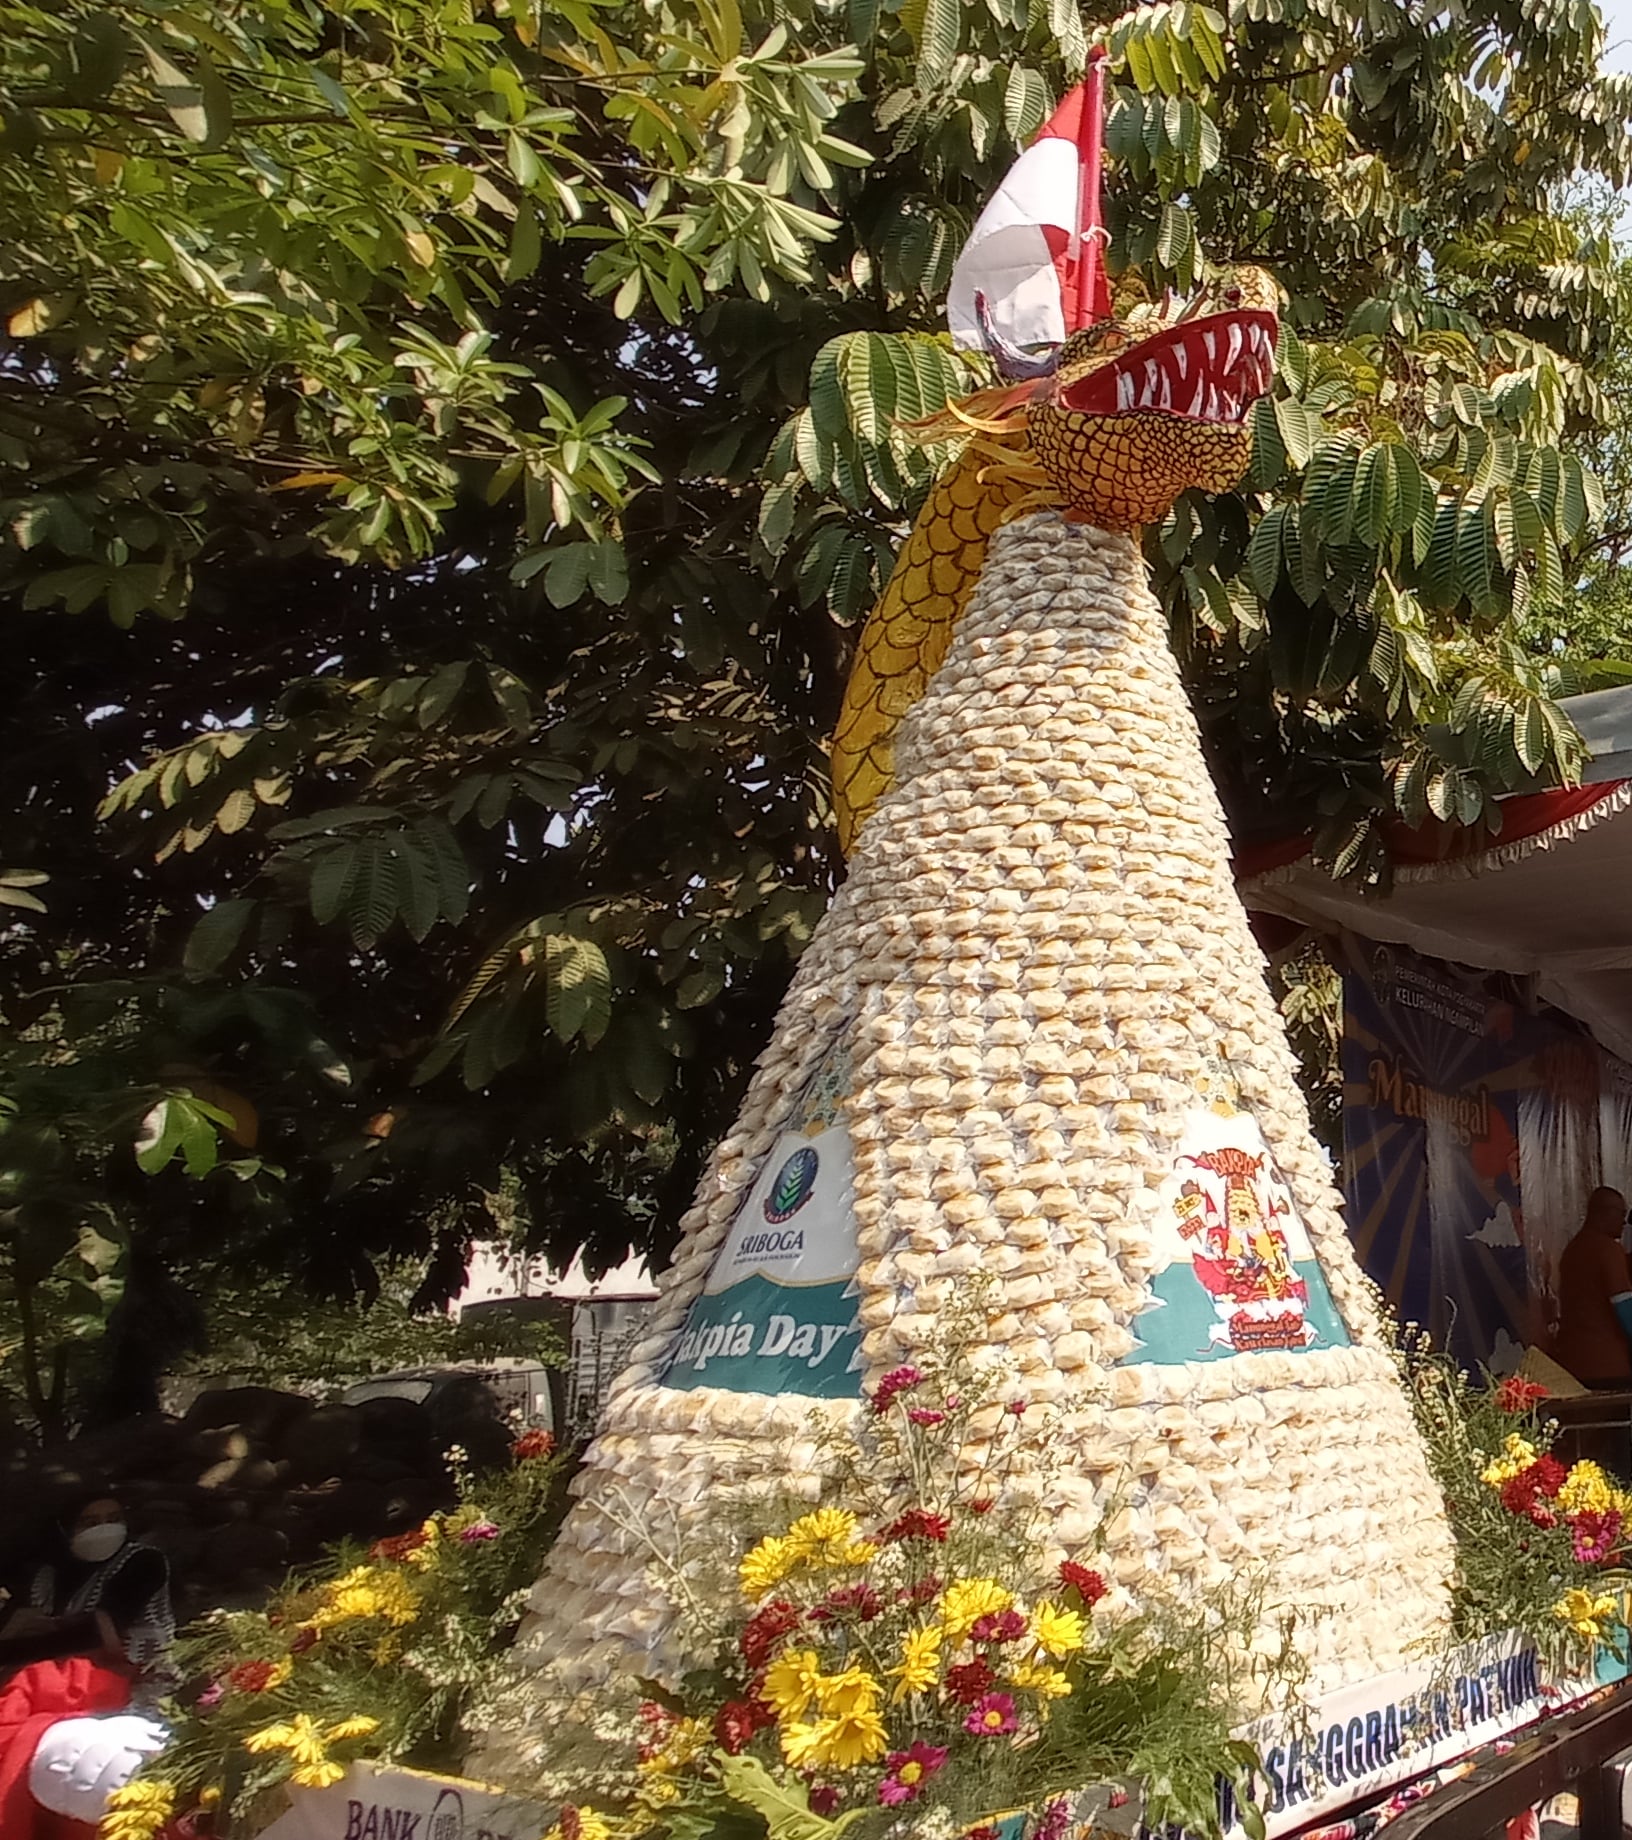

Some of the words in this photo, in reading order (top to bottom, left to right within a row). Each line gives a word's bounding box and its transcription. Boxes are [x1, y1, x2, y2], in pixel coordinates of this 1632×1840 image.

[1207, 1148, 1257, 1178] BAKPIA
[736, 1230, 804, 1257] SRIBOGA
[757, 1314, 849, 1369] Day
[1265, 1690, 1452, 1813] SAGGRAHN
[345, 1799, 422, 1840] BANK
